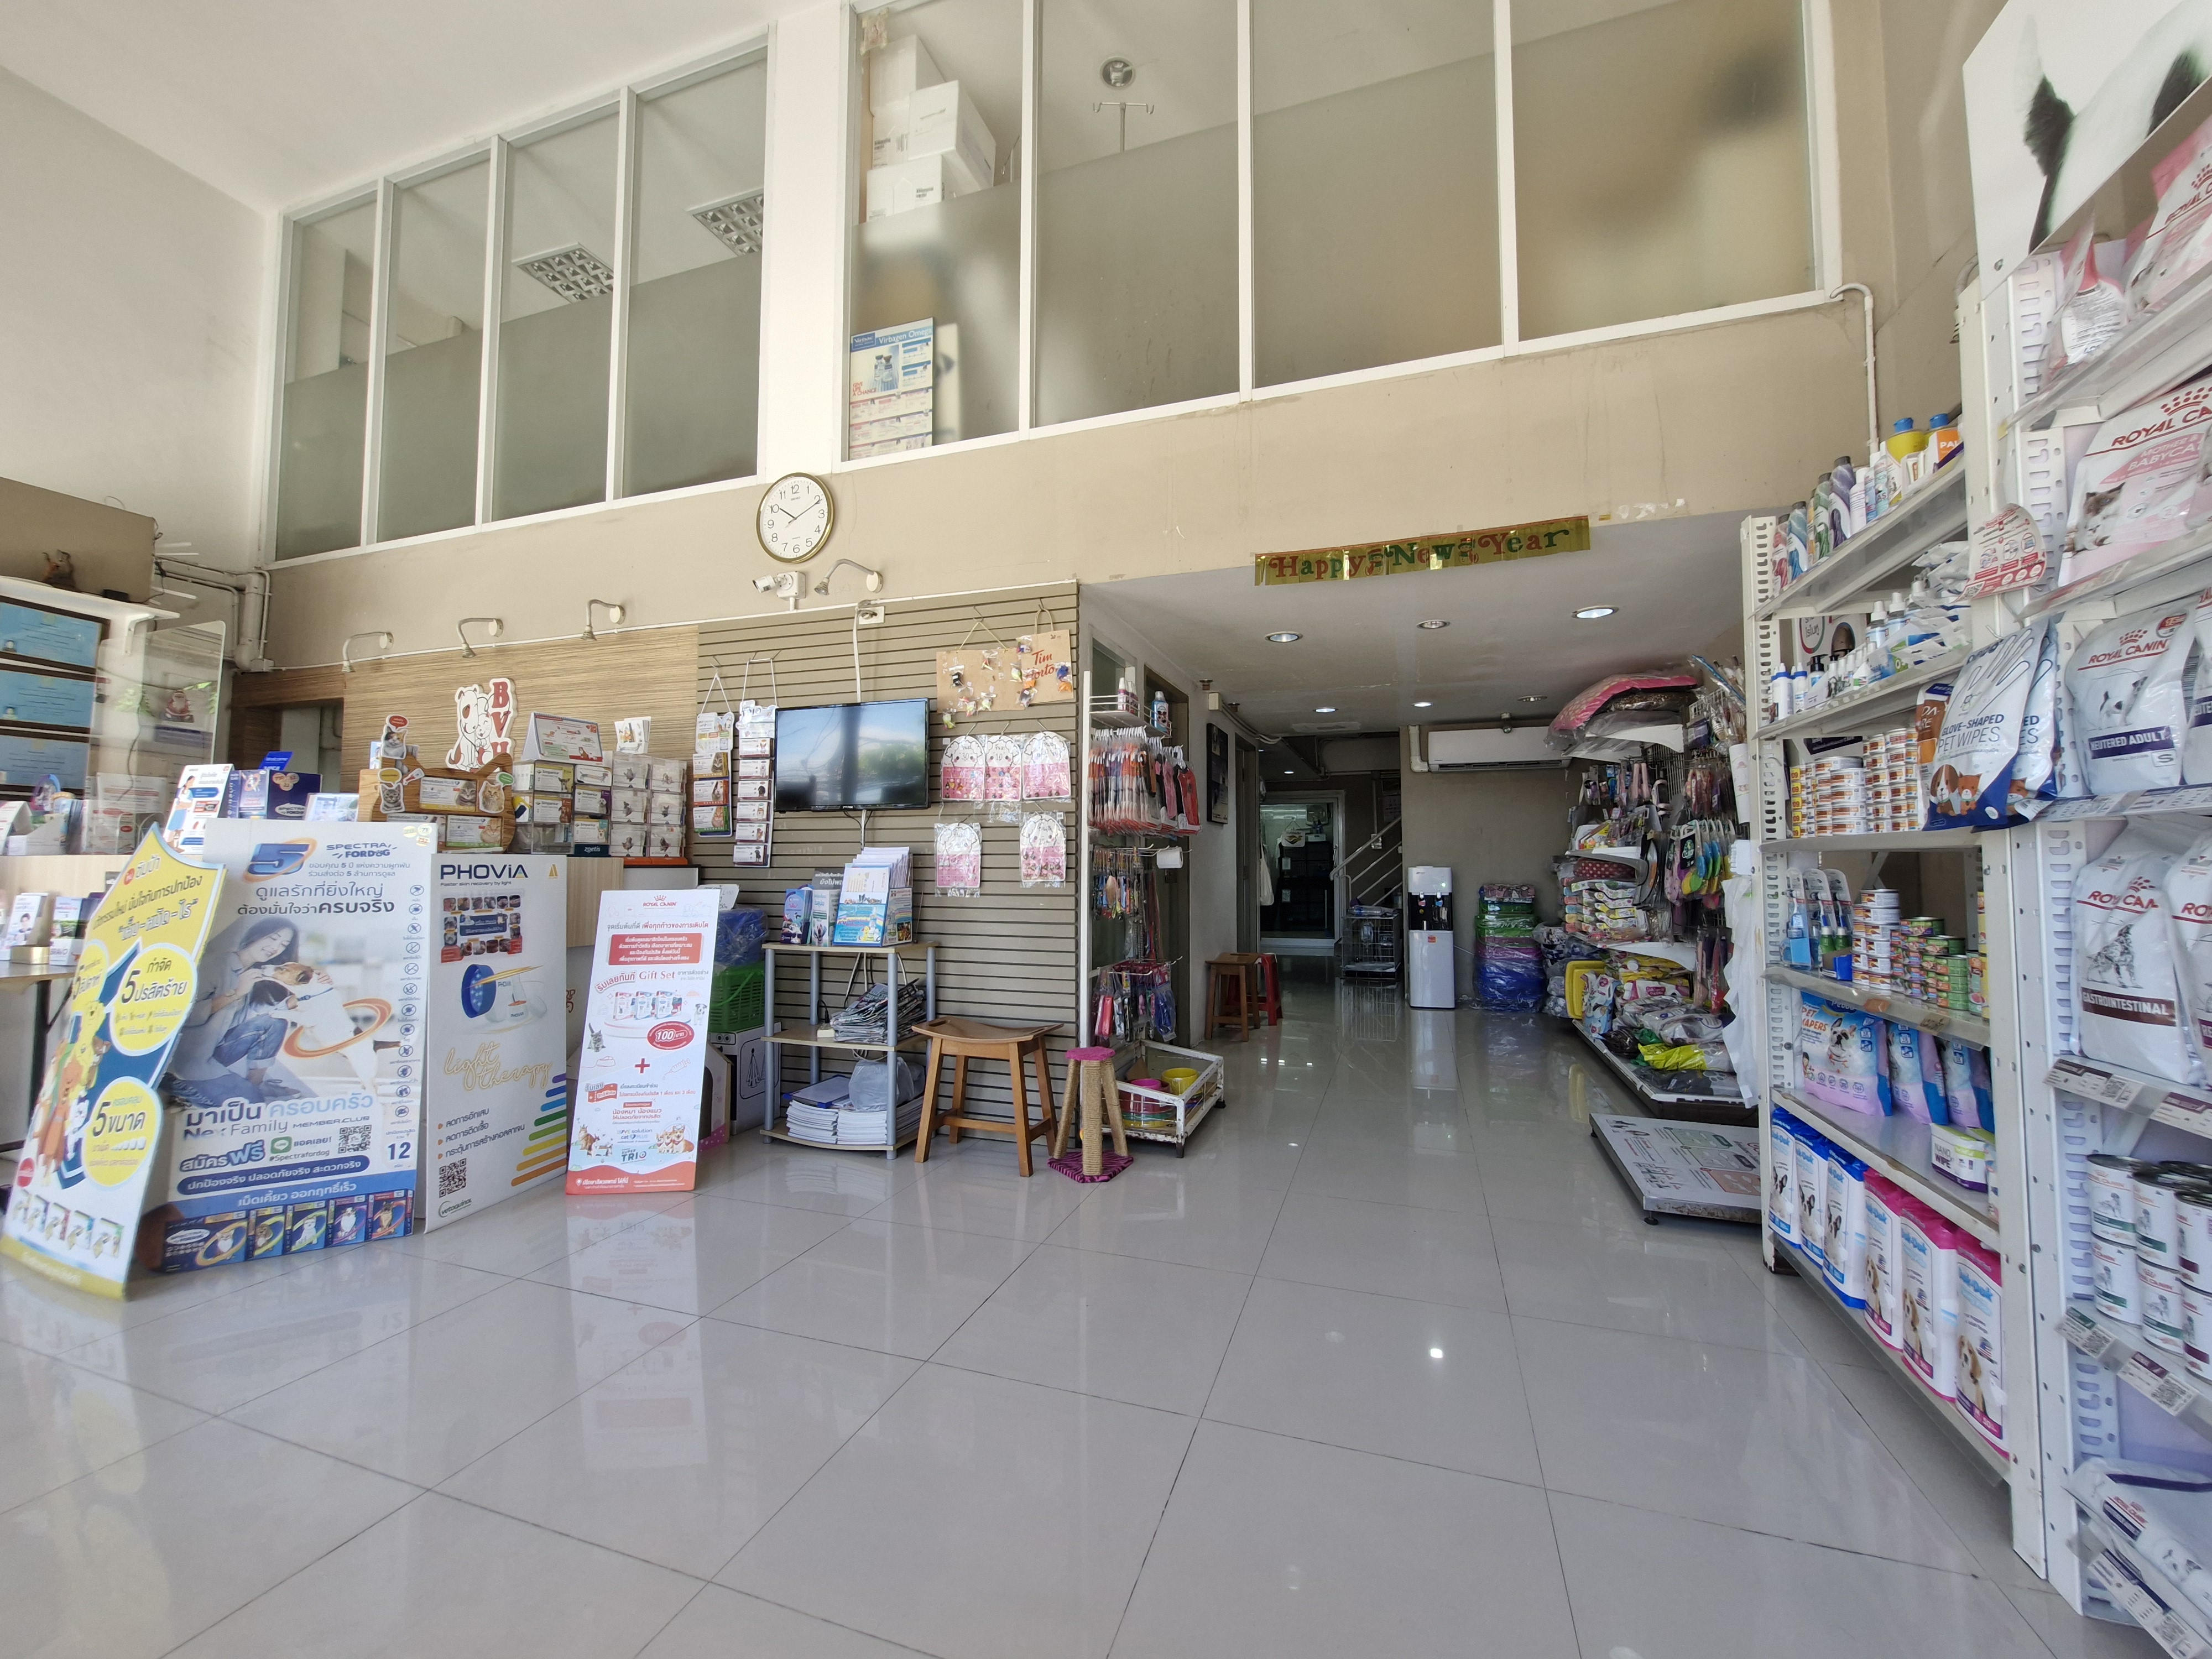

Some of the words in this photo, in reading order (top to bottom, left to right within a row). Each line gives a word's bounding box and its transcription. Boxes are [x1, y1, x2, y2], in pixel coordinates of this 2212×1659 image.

[878, 333, 907, 345] Virbagen
[2111, 416, 2176, 447] ROYAL
[779, 490, 786, 500] 11
[791, 484, 800, 494] 12
[806, 485, 810, 494] 1
[770, 504, 780, 514] 10
[818, 509, 825, 519] 3
[767, 519, 774, 529] 9
[814, 525, 821, 534] 4
[771, 533, 778, 542] 8
[805, 538, 813, 547] 5
[781, 542, 789, 552] 7
[792, 544, 800, 554] 6
[1269, 554, 1366, 580] Happy
[1476, 528, 1570, 553] Year
[1031, 649, 1053, 666] Tim
[2088, 648, 2122, 665] ROYAL
[2125, 639, 2168, 656] CANIN
[1942, 714, 2005, 737] GLOVE-SHAPED
[1938, 734, 1957, 753] PET
[1955, 726, 2001, 748] WIPES
[2090, 736, 2127, 751] NEUTERED
[2128, 729, 2166, 745] ADULT
[2158, 753, 2174, 763] S
[309, 862, 340, 871] ขอบคุณ
[255, 881, 384, 901] ดูแลรักที่ยิ่งใหญ่
[146, 957, 172, 974] กำจัด
[639, 971, 658, 980] Gift
[660, 971, 676, 979] Set
[122, 969, 142, 1004] 5
[134, 978, 188, 1003] ปรสิตร้าย
[2081, 992, 2169, 1016] GASTROINTESTINAL
[656, 1030, 675, 1041] 100
[445, 1041, 500, 1091] light
[477, 1062, 553, 1089] therapy
[186, 1100, 262, 1127] มาเป็น
[269, 1092, 374, 1118] ครอบครัว
[445, 1108, 490, 1128] ลดการอักเสบ
[92, 1101, 111, 1138] 5
[108, 1110, 146, 1134] ขนาด
[231, 1119, 288, 1136] Family
[387, 1141, 411, 1161] 12
[620, 1151, 648, 1162] TRIO
[1934, 1142, 1952, 1159] NANO
[312, 1159, 362, 1175] สะดวกจริง
